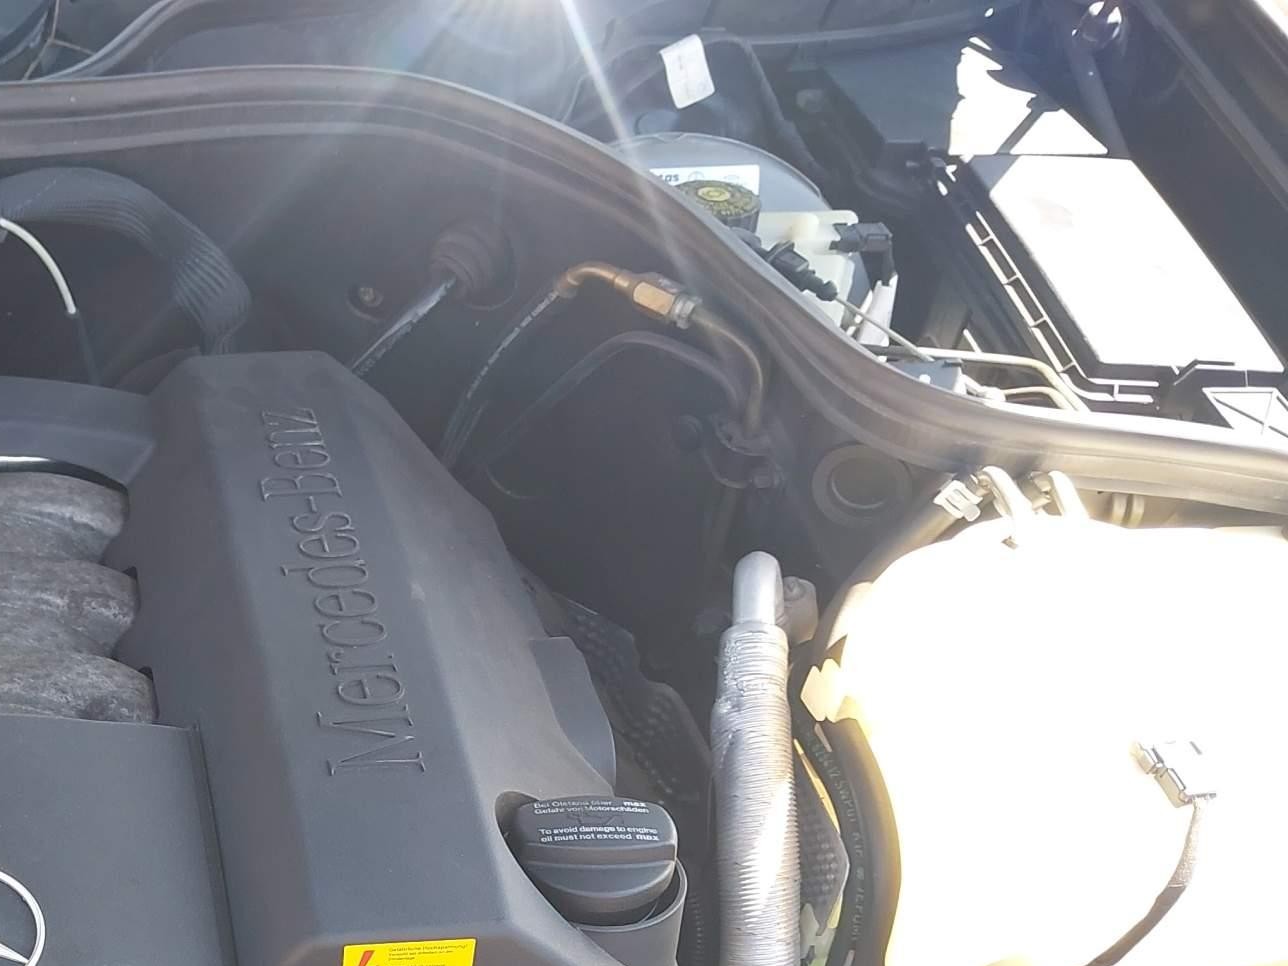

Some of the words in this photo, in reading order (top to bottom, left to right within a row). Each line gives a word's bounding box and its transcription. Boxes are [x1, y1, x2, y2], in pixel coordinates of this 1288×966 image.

[261, 407, 426, 777] Mercedes-Benz
[623, 800, 648, 808] max
[539, 828, 552, 836] To
[553, 826, 579, 835] avoid
[579, 825, 616, 834] damage
[626, 826, 658, 835] engine
[540, 834, 553, 843] oil
[554, 833, 579, 842] must
[579, 833, 596, 841] not
[596, 832, 633, 841] exceed
[635, 832, 660, 842] max
